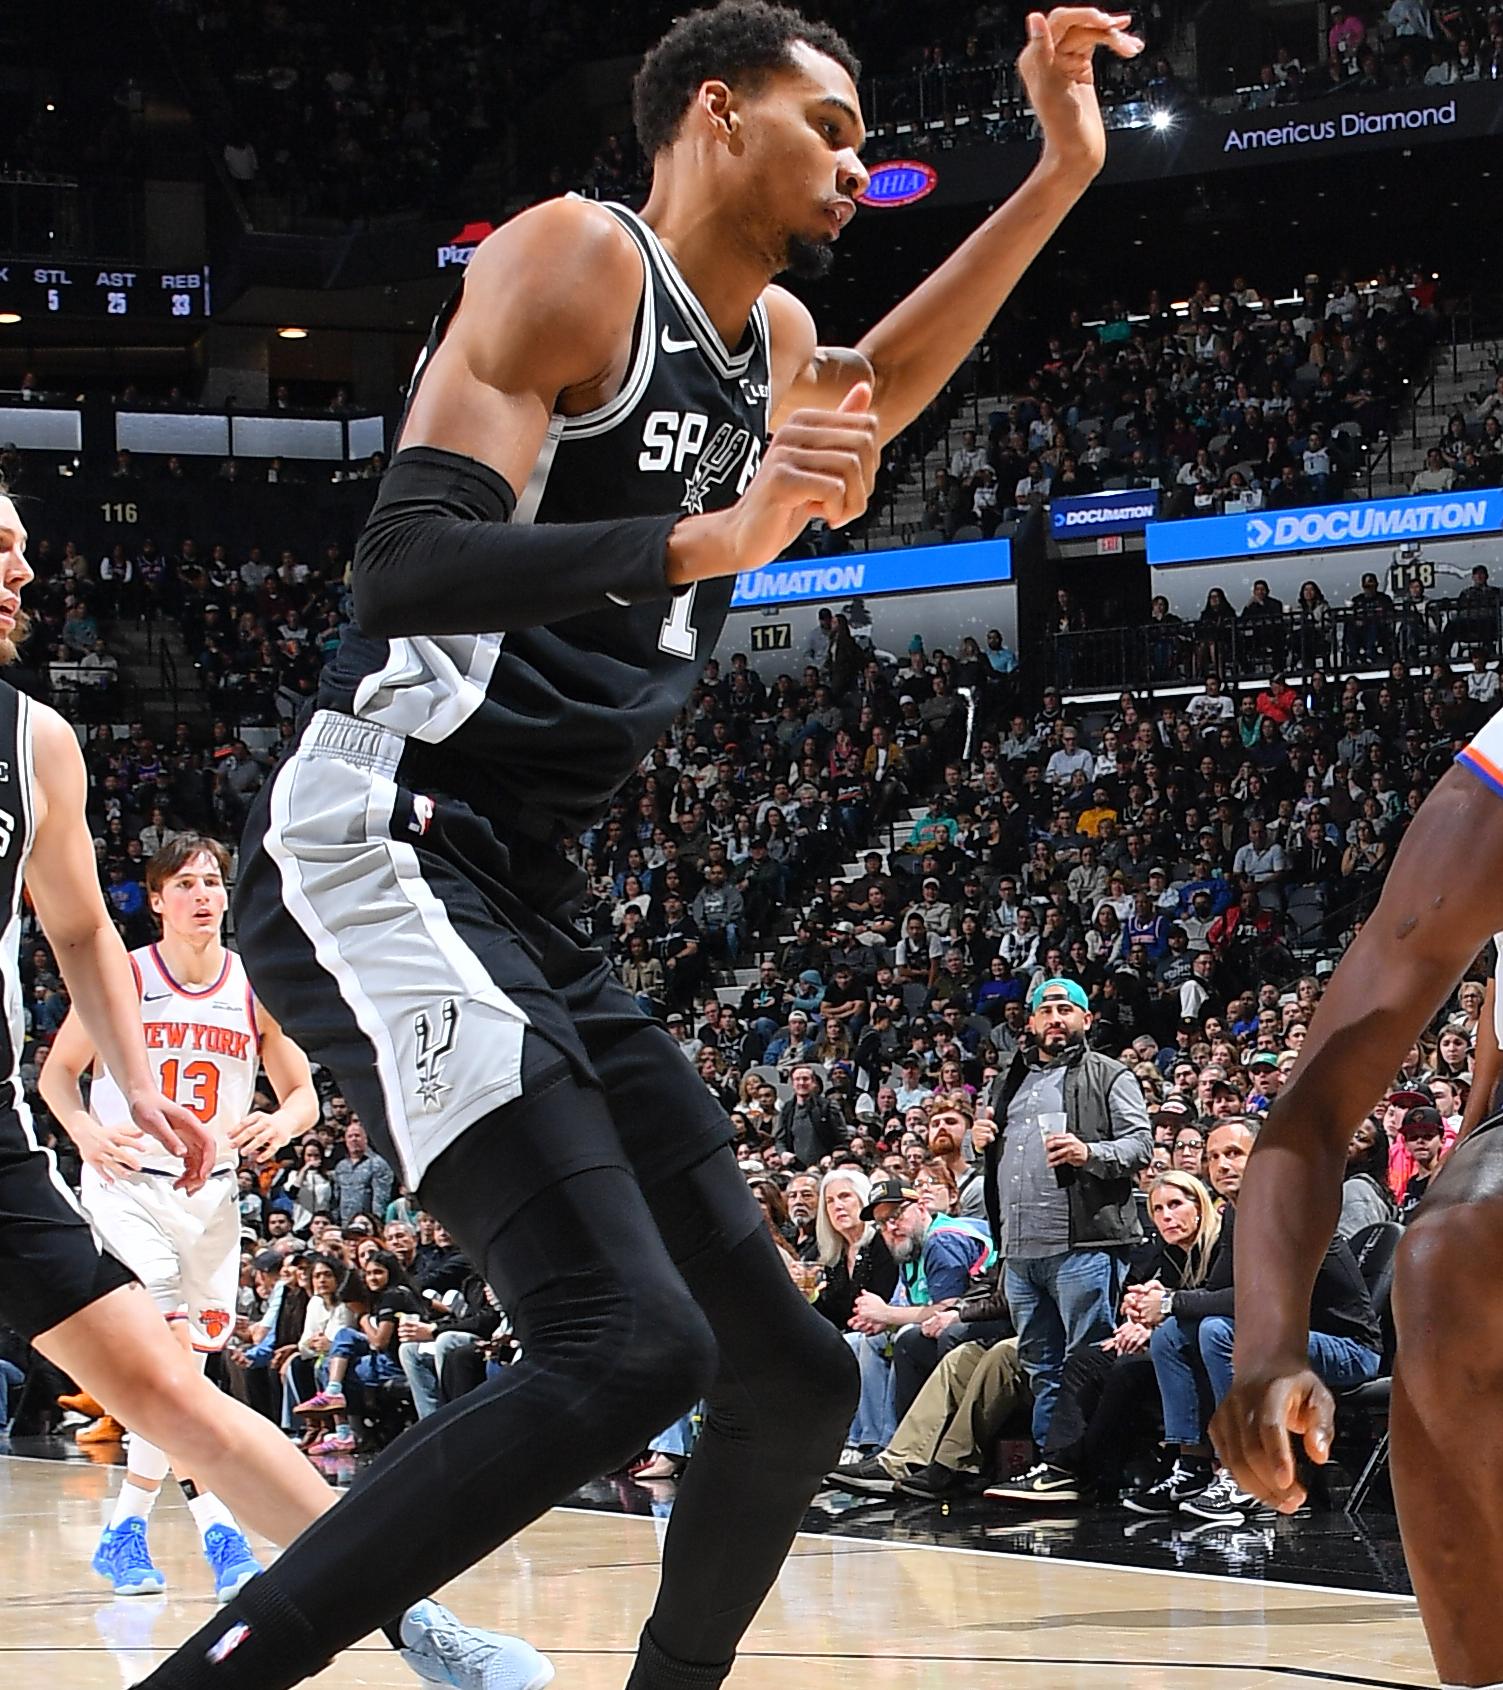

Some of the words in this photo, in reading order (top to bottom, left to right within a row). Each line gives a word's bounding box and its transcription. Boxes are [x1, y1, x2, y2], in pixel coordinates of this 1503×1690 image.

[1223, 121, 1336, 152] Americus
[1341, 100, 1456, 137] Diamond
[867, 172, 919, 195] AHIA
[34, 269, 72, 285] STL
[96, 272, 136, 288] AST
[161, 274, 200, 289] REB
[48, 289, 59, 311] 5
[107, 292, 127, 314] 25
[172, 294, 191, 316] 33
[101, 503, 138, 523] 116
[1066, 505, 1154, 526] DOCUMATION
[1274, 501, 1487, 546] DOCUMATION
[737, 564, 865, 599] UMATION
[1393, 564, 1433, 588] 118
[658, 580, 697, 661] 1
[753, 625, 789, 649] 117
[191, 1022, 250, 1061] YORK
[160, 1058, 220, 1124] 13
